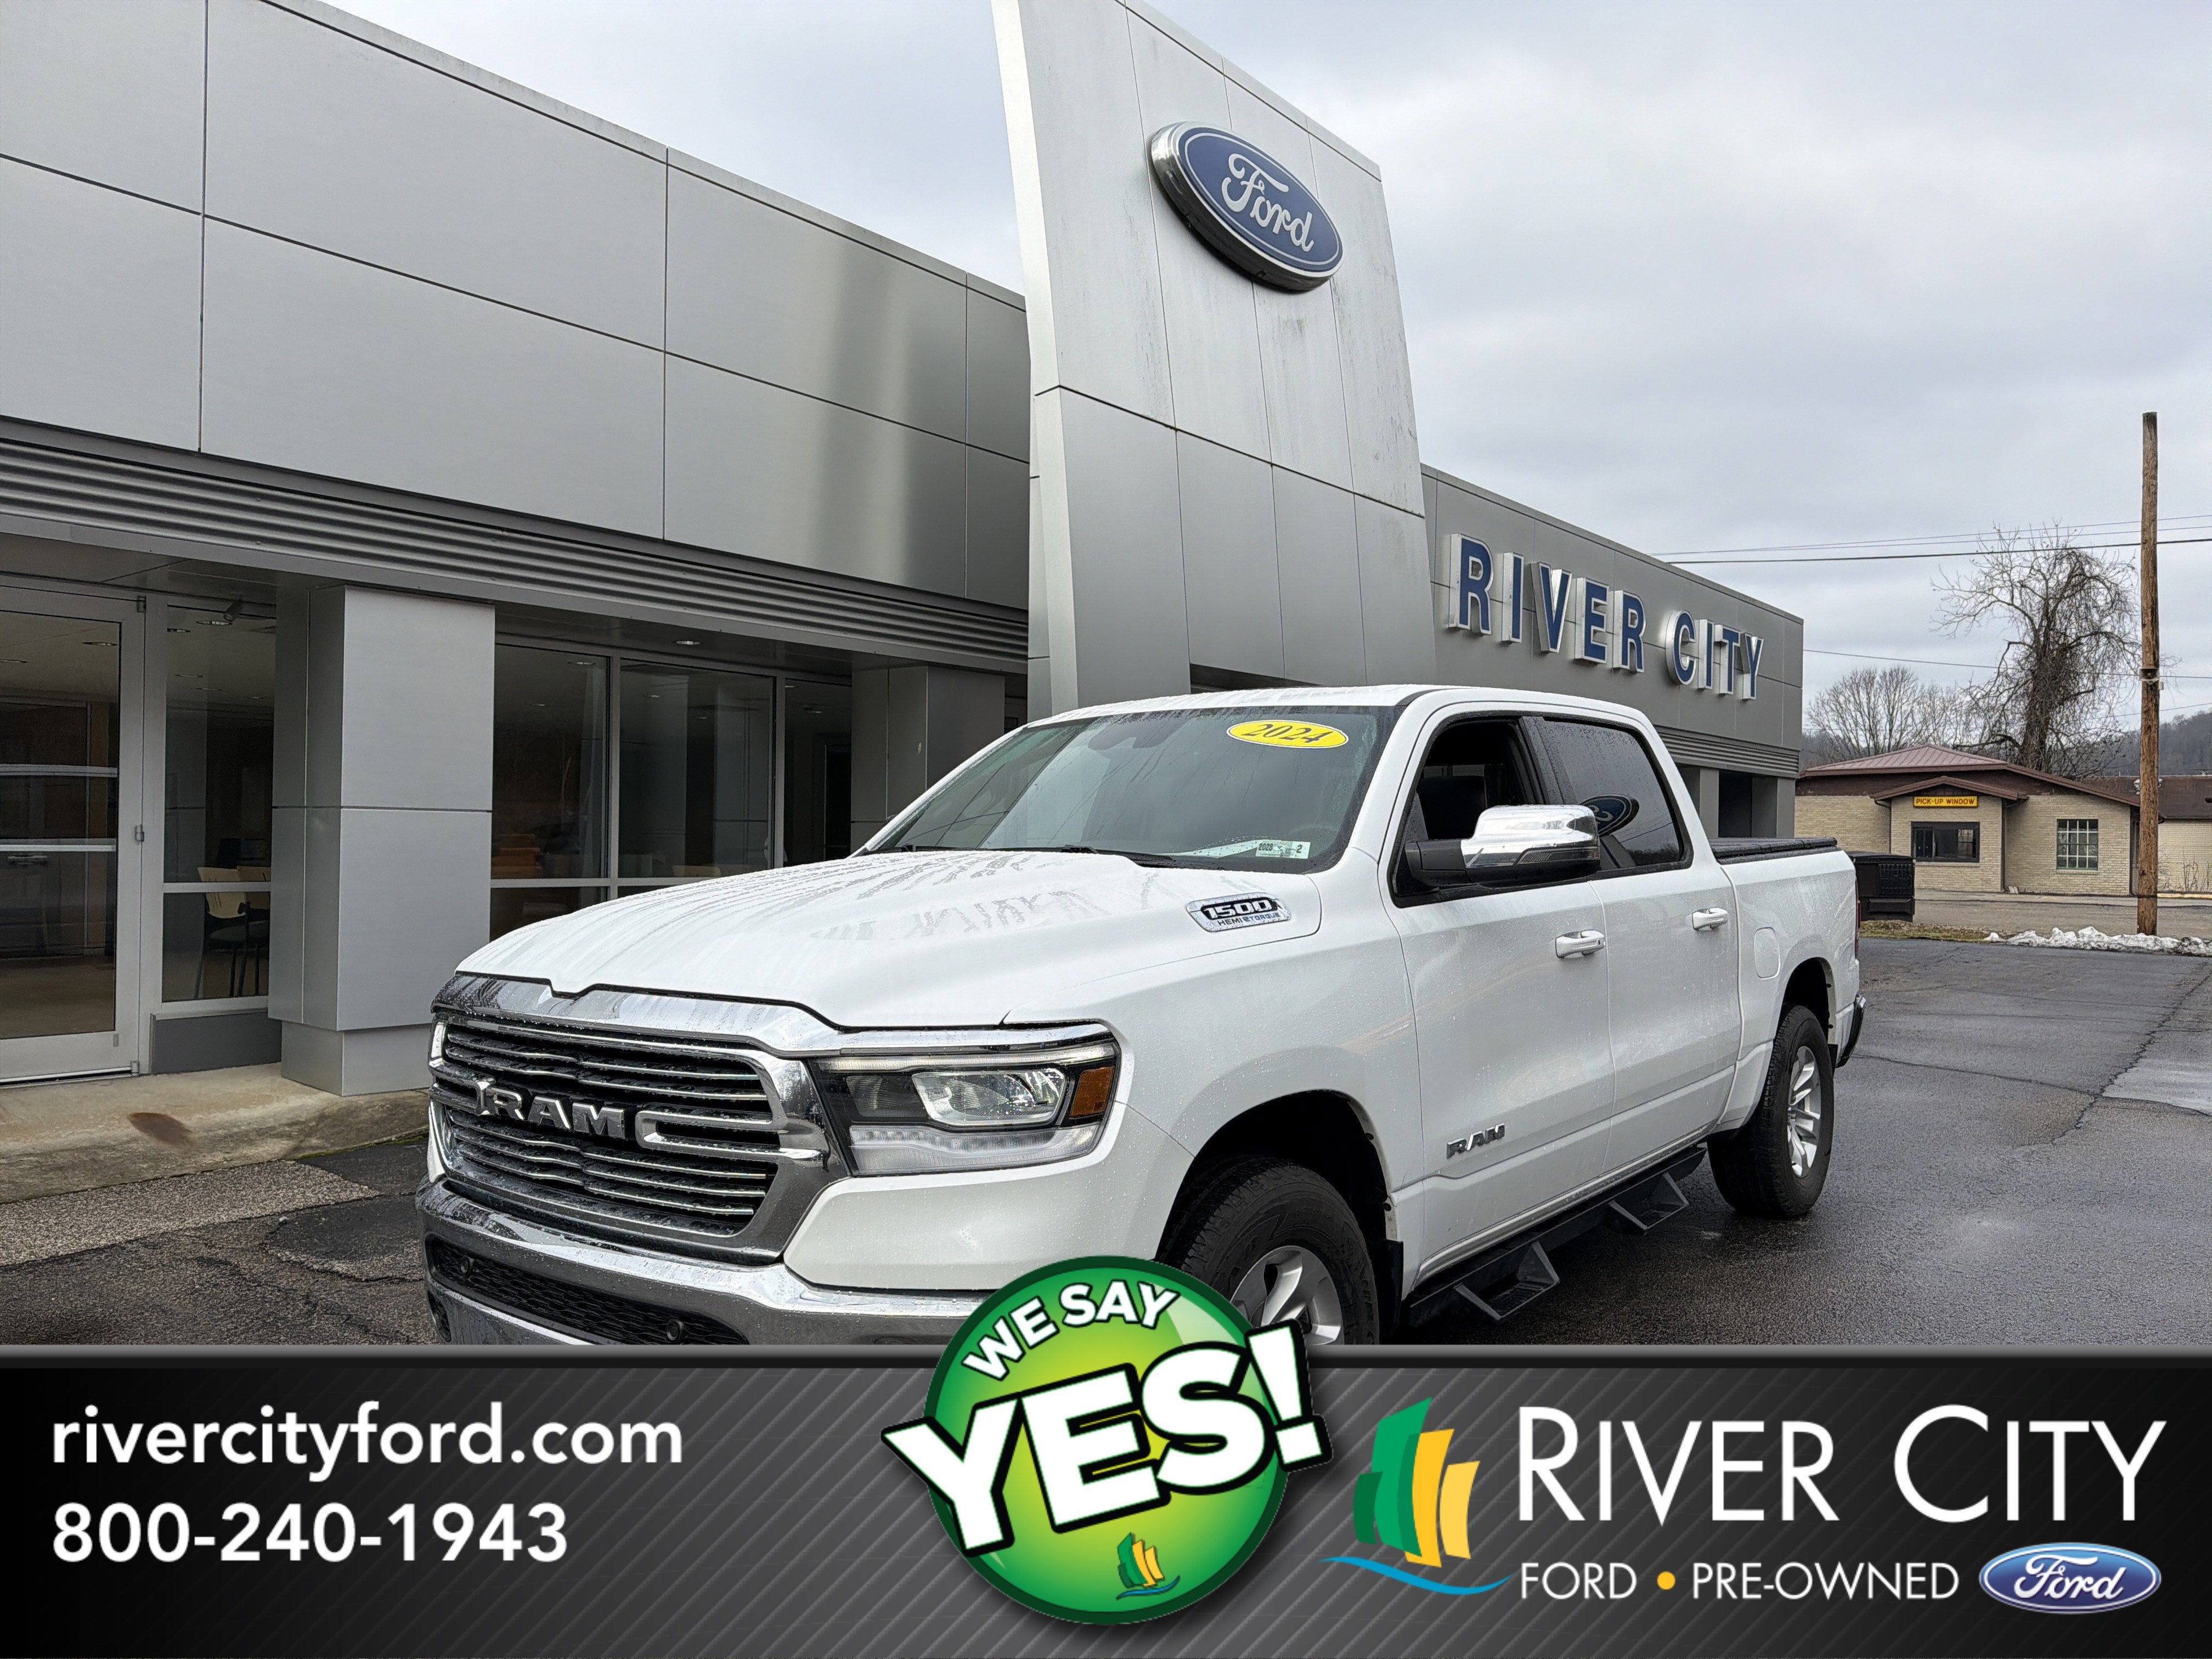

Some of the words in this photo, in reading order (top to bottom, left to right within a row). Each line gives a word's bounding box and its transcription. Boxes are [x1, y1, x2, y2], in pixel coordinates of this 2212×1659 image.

[1221, 153, 1314, 252] Ford
[1449, 533, 1646, 673] RIVER
[1666, 610, 1764, 700] CITY
[1240, 723, 1334, 743] 2024
[1203, 899, 1272, 919] 1500
[1217, 917, 1243, 927] HEMI
[485, 1086, 625, 1140] RAM
[1446, 1122, 1505, 1159] RAM
